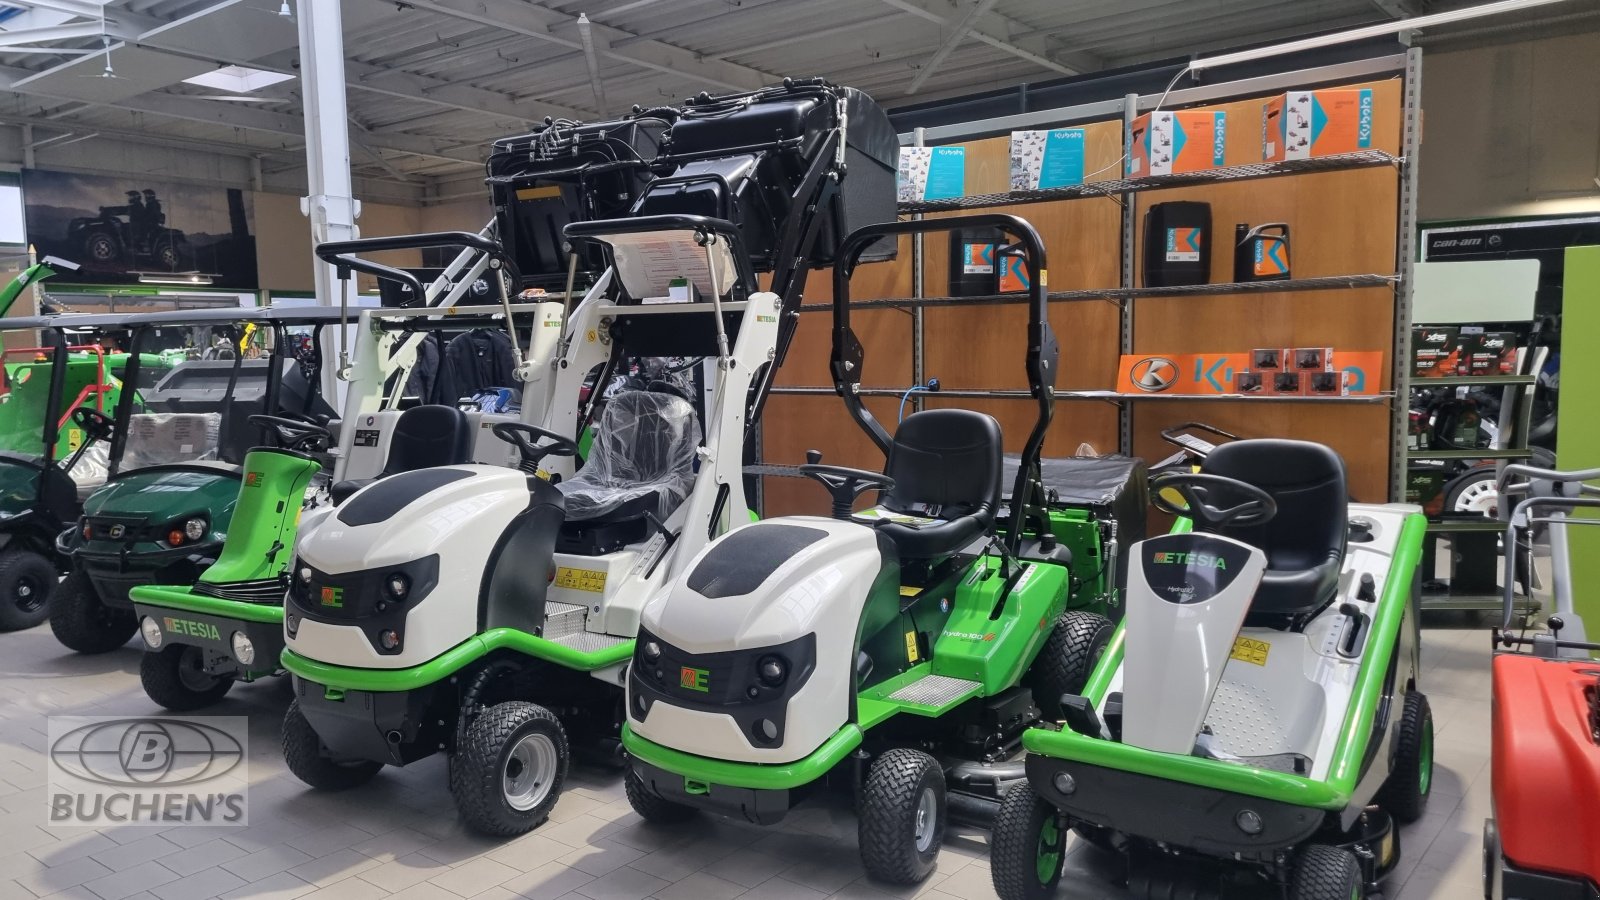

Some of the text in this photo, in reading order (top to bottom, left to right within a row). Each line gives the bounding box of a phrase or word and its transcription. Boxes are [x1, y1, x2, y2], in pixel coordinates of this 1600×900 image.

[1359, 96, 1370, 141] Kubota
[1214, 118, 1224, 159] Kubota
[1432, 237, 1482, 248] can-am
[1160, 552, 1227, 570] ETESIA
[170, 617, 221, 641] ETESIA
